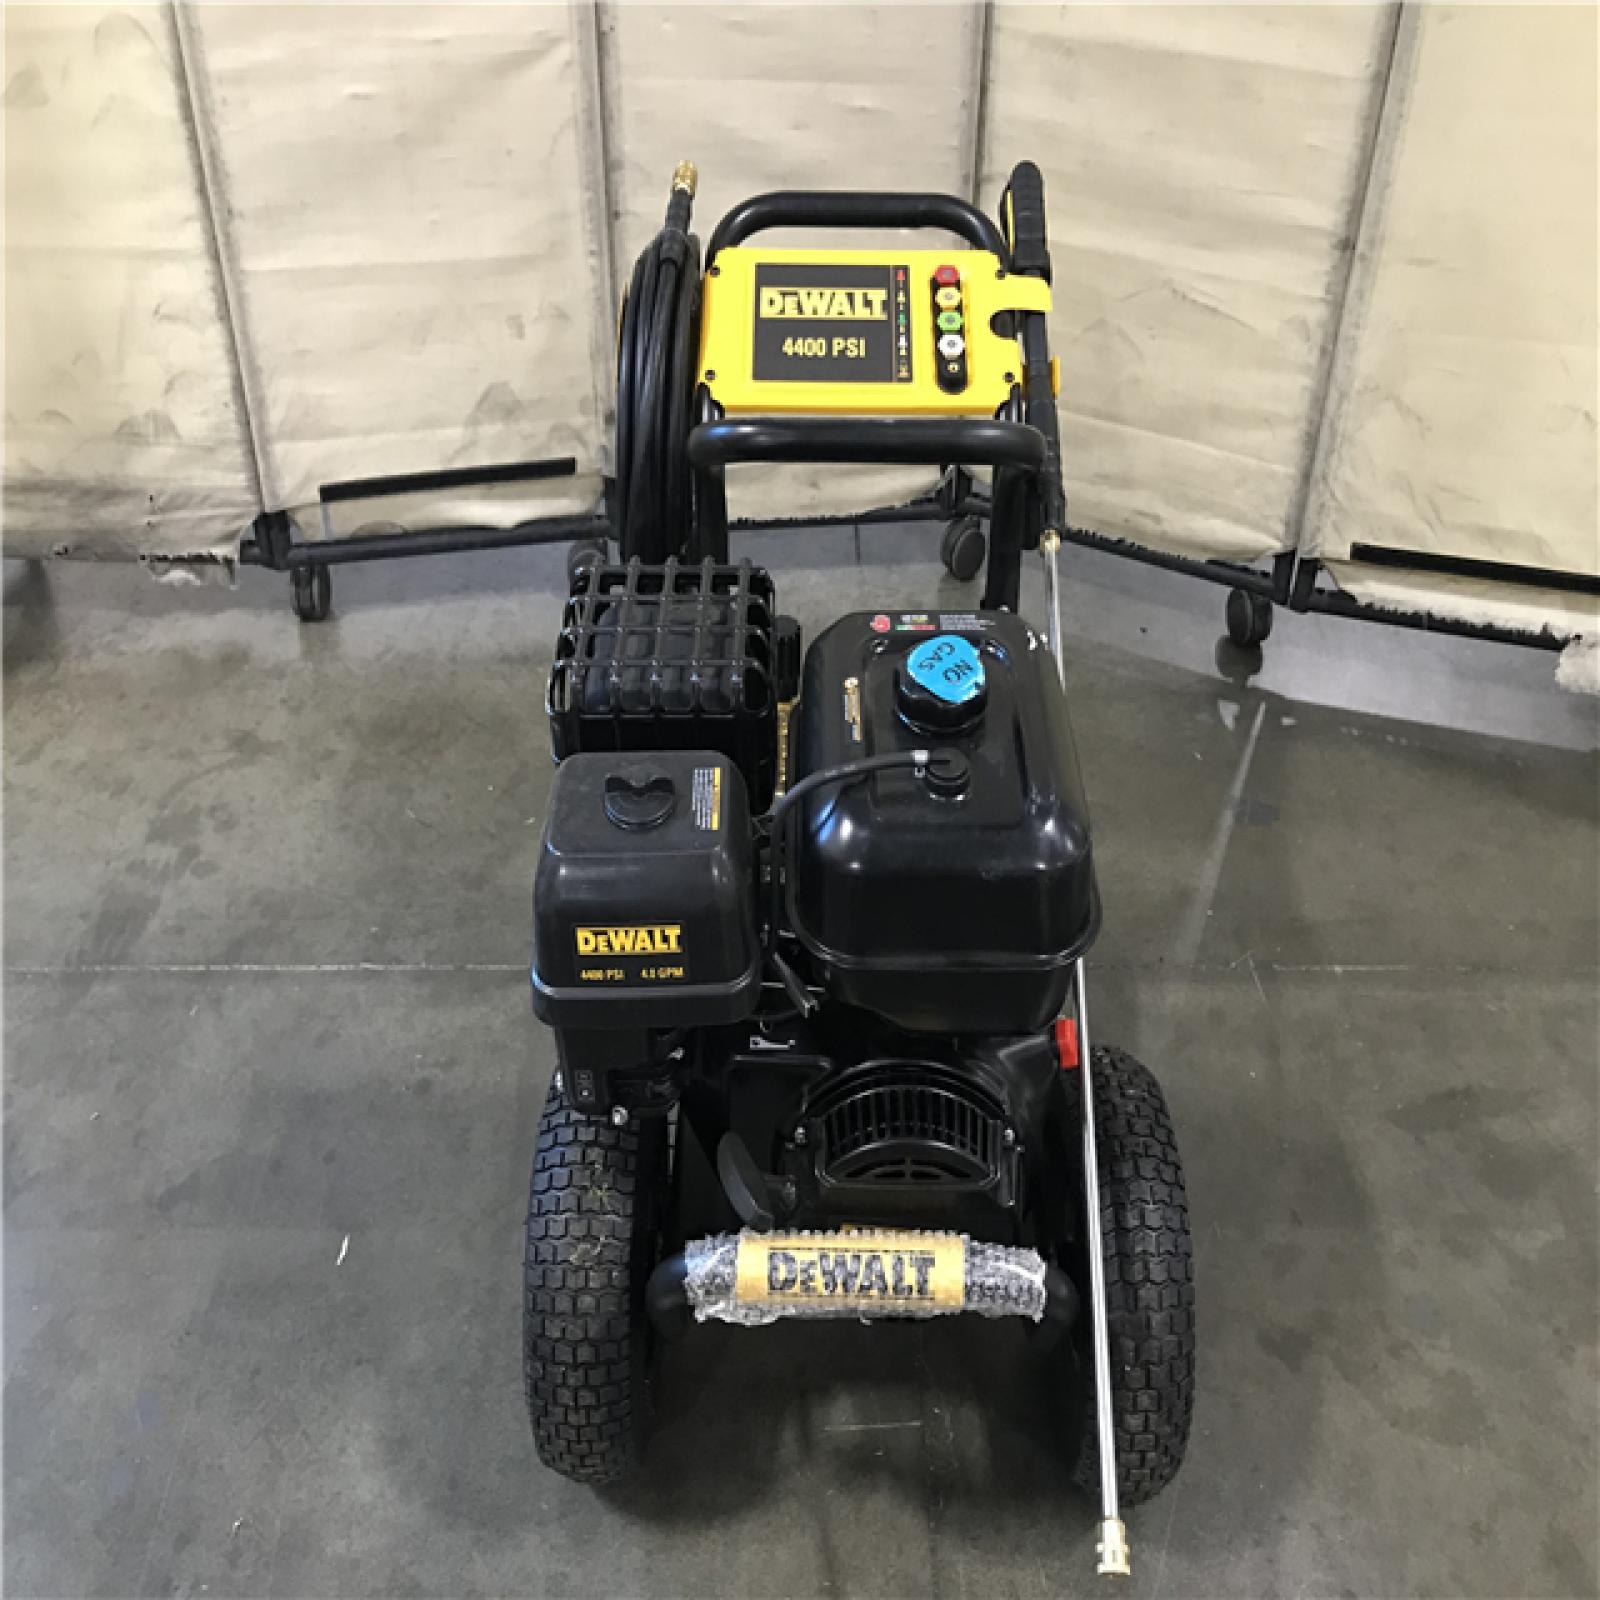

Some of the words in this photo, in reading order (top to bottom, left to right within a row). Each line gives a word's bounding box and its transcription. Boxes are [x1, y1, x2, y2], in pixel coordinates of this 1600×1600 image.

[782, 336, 828, 358] 4400
[831, 337, 867, 358] PSI
[943, 659, 974, 685] NO
